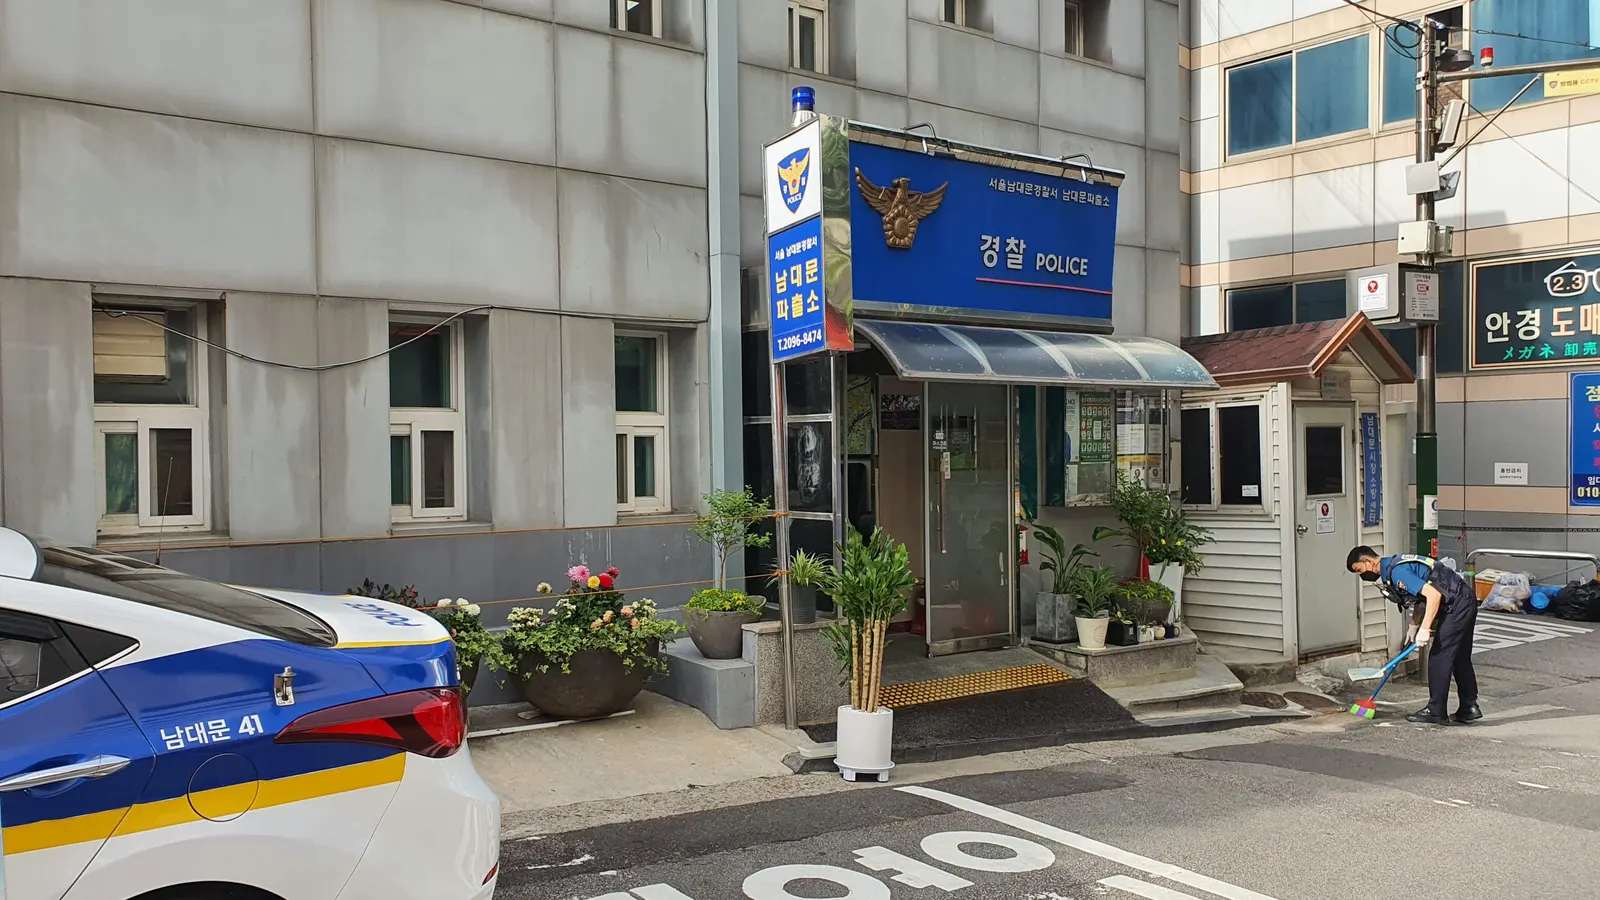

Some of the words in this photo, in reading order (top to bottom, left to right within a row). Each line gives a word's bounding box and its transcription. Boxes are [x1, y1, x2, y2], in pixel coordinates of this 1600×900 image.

[787, 193, 802, 205] POLICE
[989, 178, 1058, 199] 서울남대문경찰서
[1063, 190, 1110, 207] 남대문파출소
[774, 248, 785, 261] 서울
[786, 236, 818, 258] 남대문경찰서
[980, 234, 1027, 270] 경찰
[1036, 253, 1088, 276] POLICE
[775, 258, 819, 294] 남대문
[776, 289, 820, 321] 파출소
[777, 328, 822, 352] T.2096-8474
[1485, 308, 1541, 343] 안경
[1503, 344, 1555, 361] メガネ
[160, 718, 231, 751] 남대문
[238, 714, 264, 736] 41
